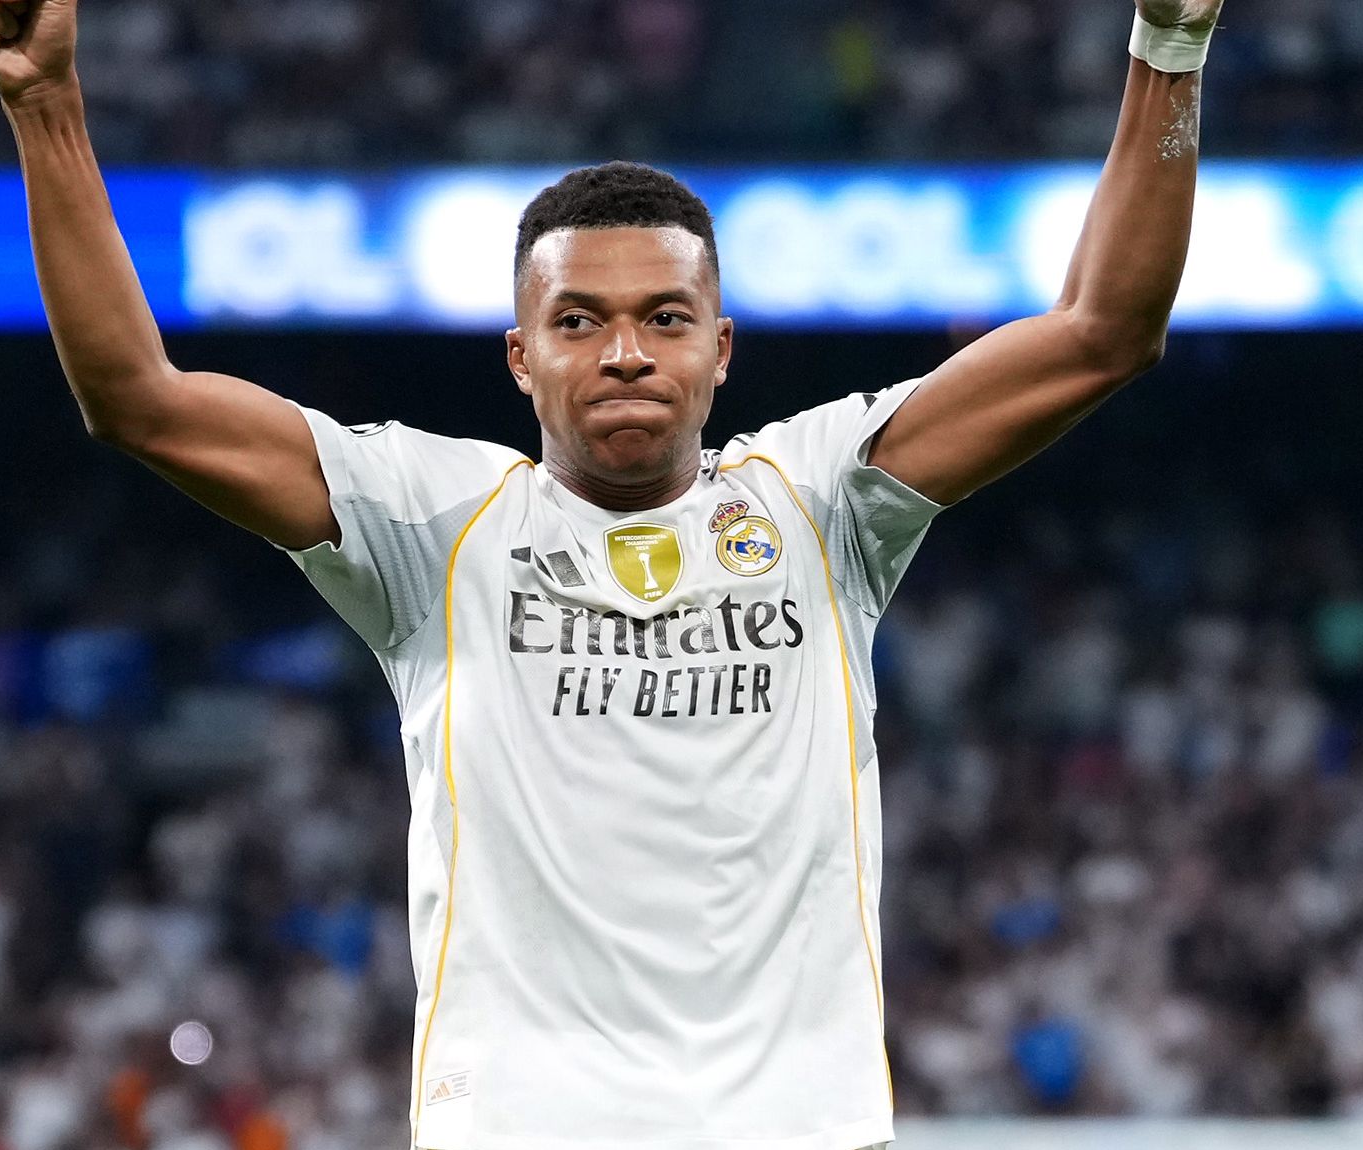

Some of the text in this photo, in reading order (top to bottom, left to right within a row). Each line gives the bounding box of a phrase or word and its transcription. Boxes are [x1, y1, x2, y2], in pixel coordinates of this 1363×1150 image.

[510, 590, 803, 659] Emirates
[552, 662, 772, 717] FLY BETTER
